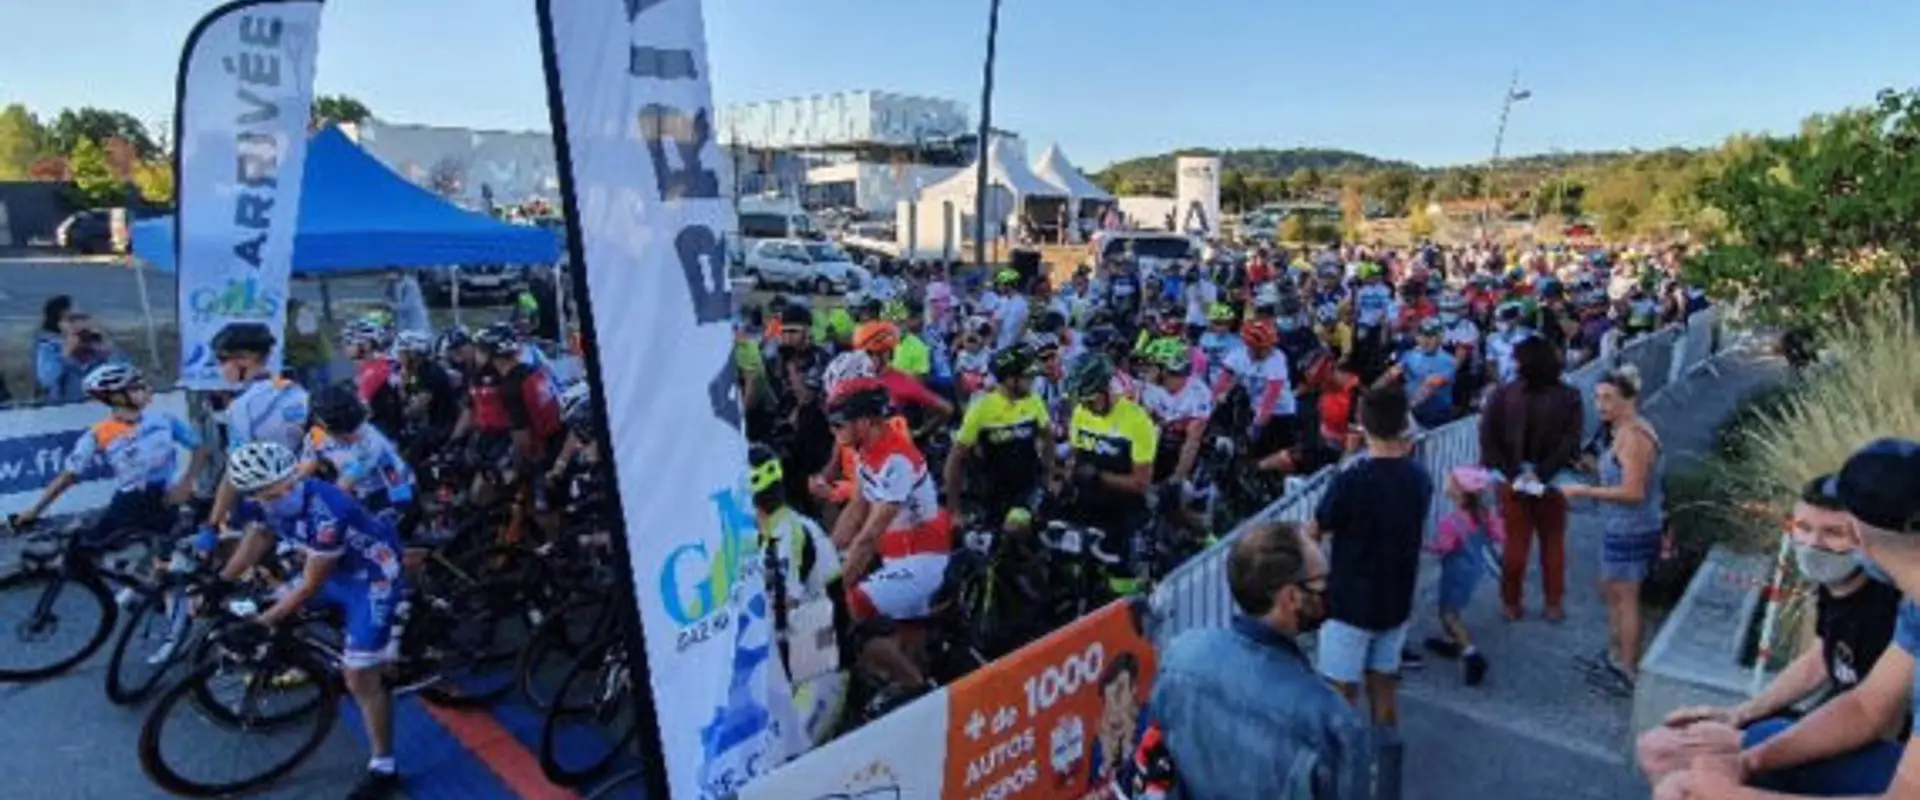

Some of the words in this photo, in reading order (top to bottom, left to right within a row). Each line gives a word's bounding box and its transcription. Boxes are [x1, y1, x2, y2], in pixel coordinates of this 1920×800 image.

[221, 14, 283, 270] ARRIVÉE
[1023, 641, 1105, 718] 1000
[964, 726, 1036, 788] AUTOS
